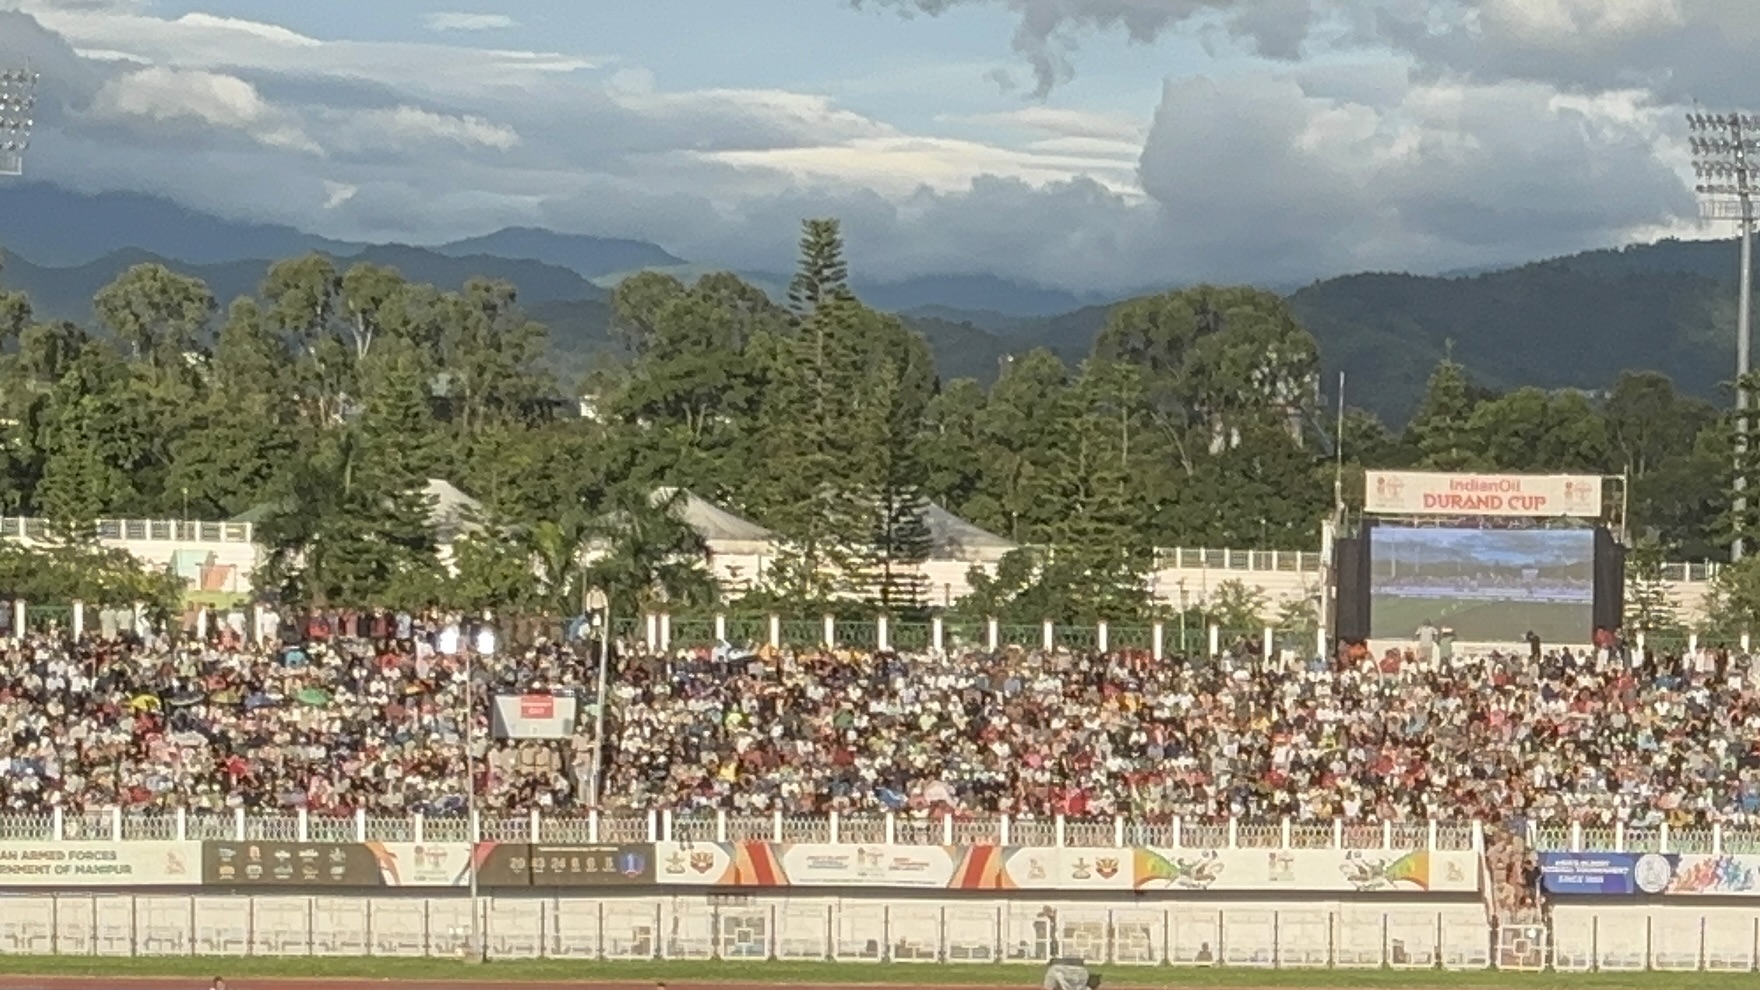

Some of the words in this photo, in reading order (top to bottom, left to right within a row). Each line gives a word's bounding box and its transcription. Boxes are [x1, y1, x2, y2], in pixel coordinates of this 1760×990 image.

[1450, 478, 1521, 494] IndianOil
[1423, 493, 1504, 510] DURAND
[1508, 496, 1546, 512] CUP
[21, 850, 65, 861] ARMED
[68, 850, 117, 861] FORCES
[54, 864, 71, 875] OF
[75, 864, 133, 875] MANIPUR
